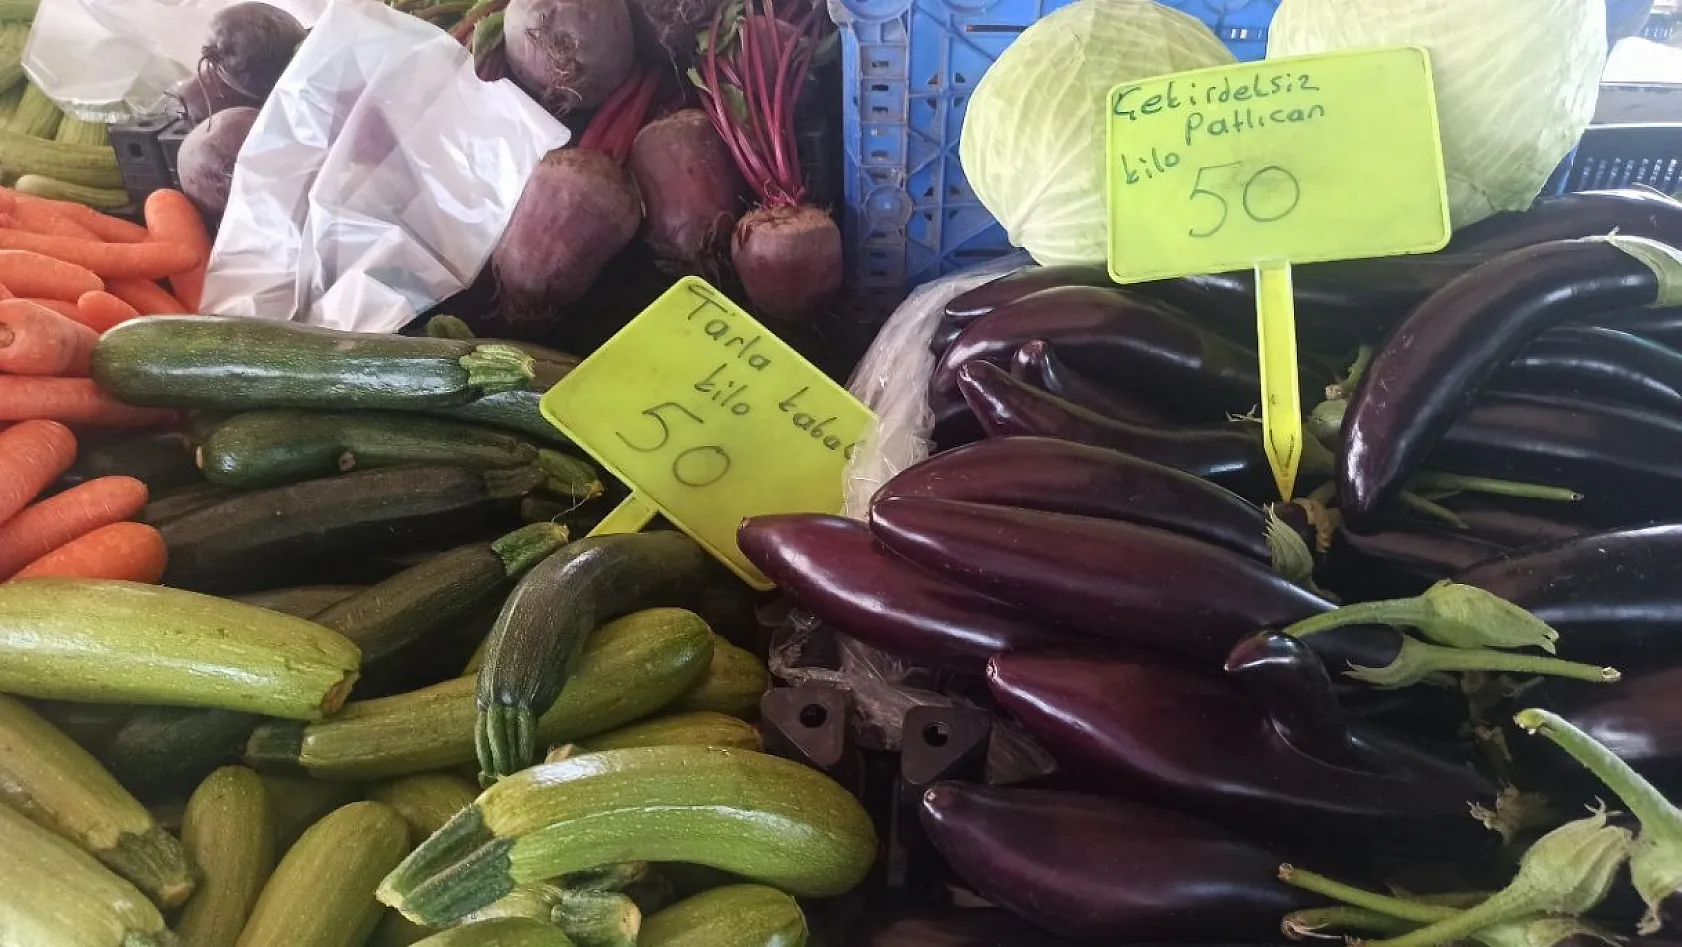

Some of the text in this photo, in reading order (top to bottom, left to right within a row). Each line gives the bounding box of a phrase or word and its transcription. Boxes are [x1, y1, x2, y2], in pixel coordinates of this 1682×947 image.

[1120, 147, 1180, 185] kilo
[1188, 160, 1301, 238] 50
[686, 283, 772, 371] Tarla
[694, 363, 751, 416] kilo
[615, 402, 731, 488] 50
